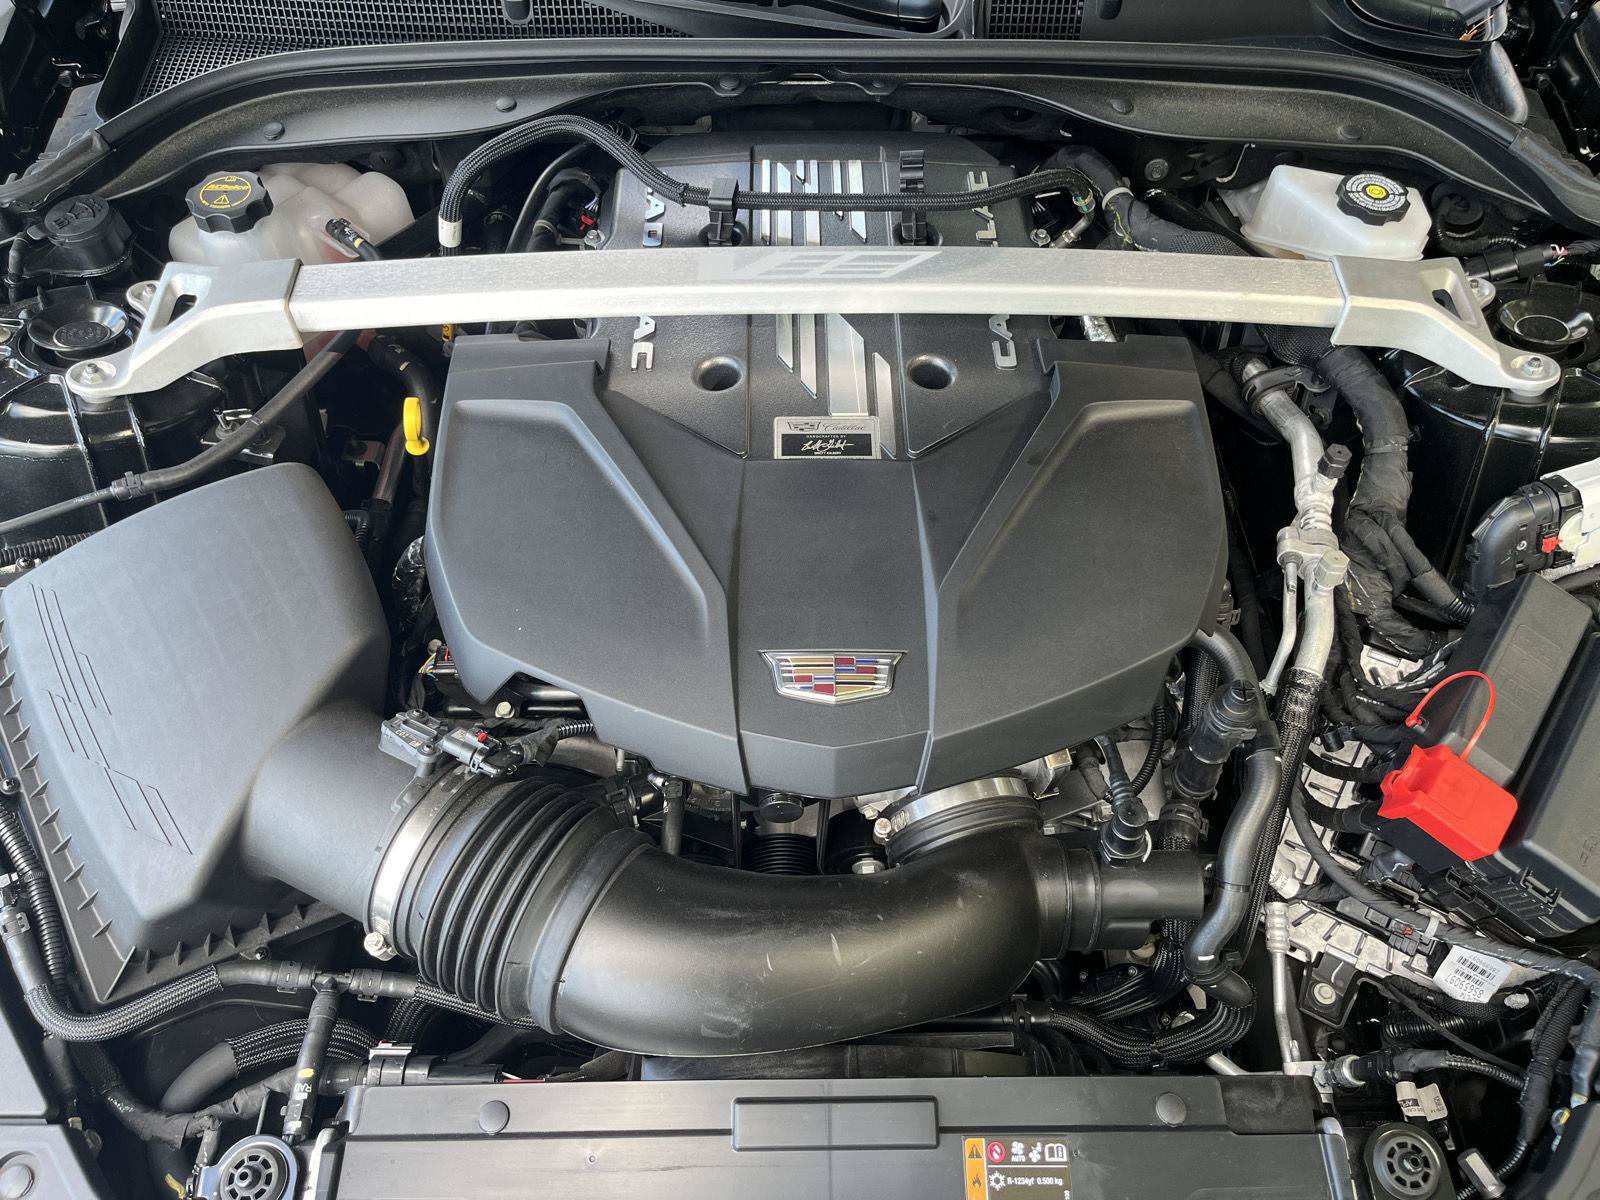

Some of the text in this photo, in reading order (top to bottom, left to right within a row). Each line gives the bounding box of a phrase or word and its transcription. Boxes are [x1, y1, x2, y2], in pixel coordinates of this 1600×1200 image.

[823, 423, 865, 431] Cadillac
[1445, 974, 1484, 999] 85659097
[1007, 1177, 1063, 1186] R-1234yf 0.500 kg
